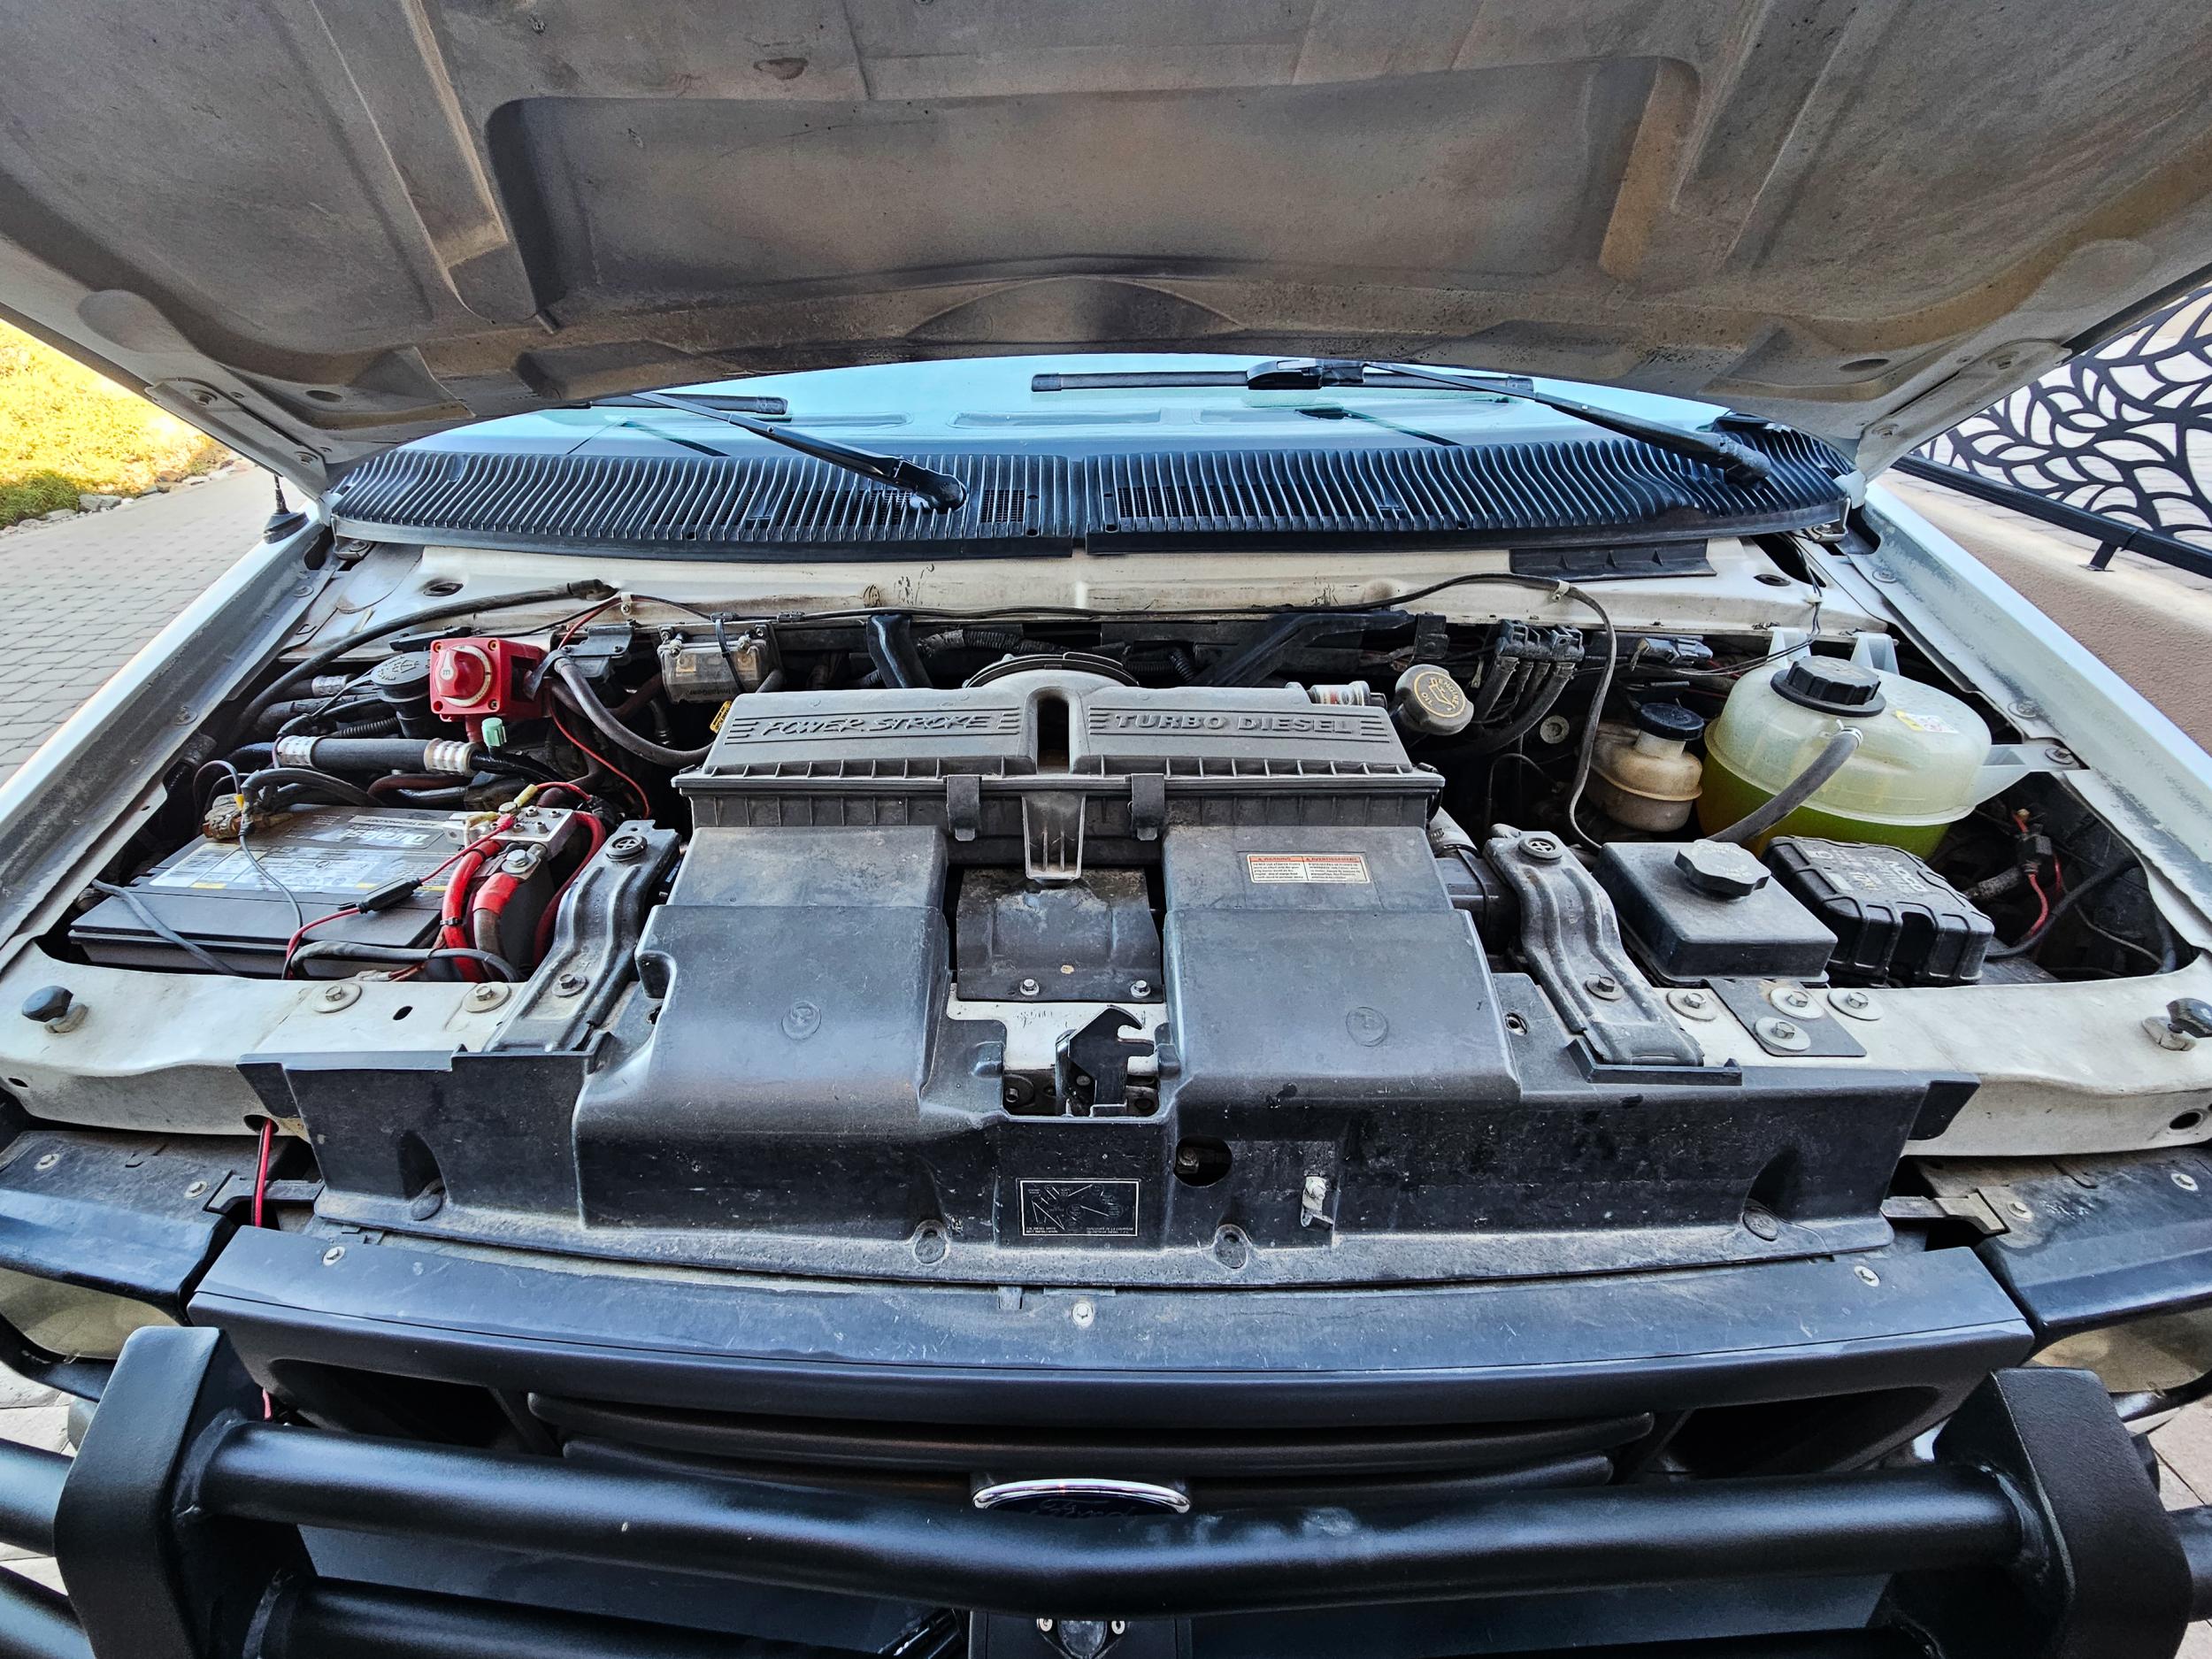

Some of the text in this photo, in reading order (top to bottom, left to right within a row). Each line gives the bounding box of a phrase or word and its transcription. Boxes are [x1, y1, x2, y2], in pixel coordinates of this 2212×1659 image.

[1421, 692, 1432, 707] OIL
[1438, 678, 1459, 706] ENGINE
[761, 715, 991, 735] POWER STROKE
[1115, 714, 1354, 734] TURBO DIESEL
[340, 828, 431, 846] Duralast
[1885, 860, 1929, 892] NOCO
